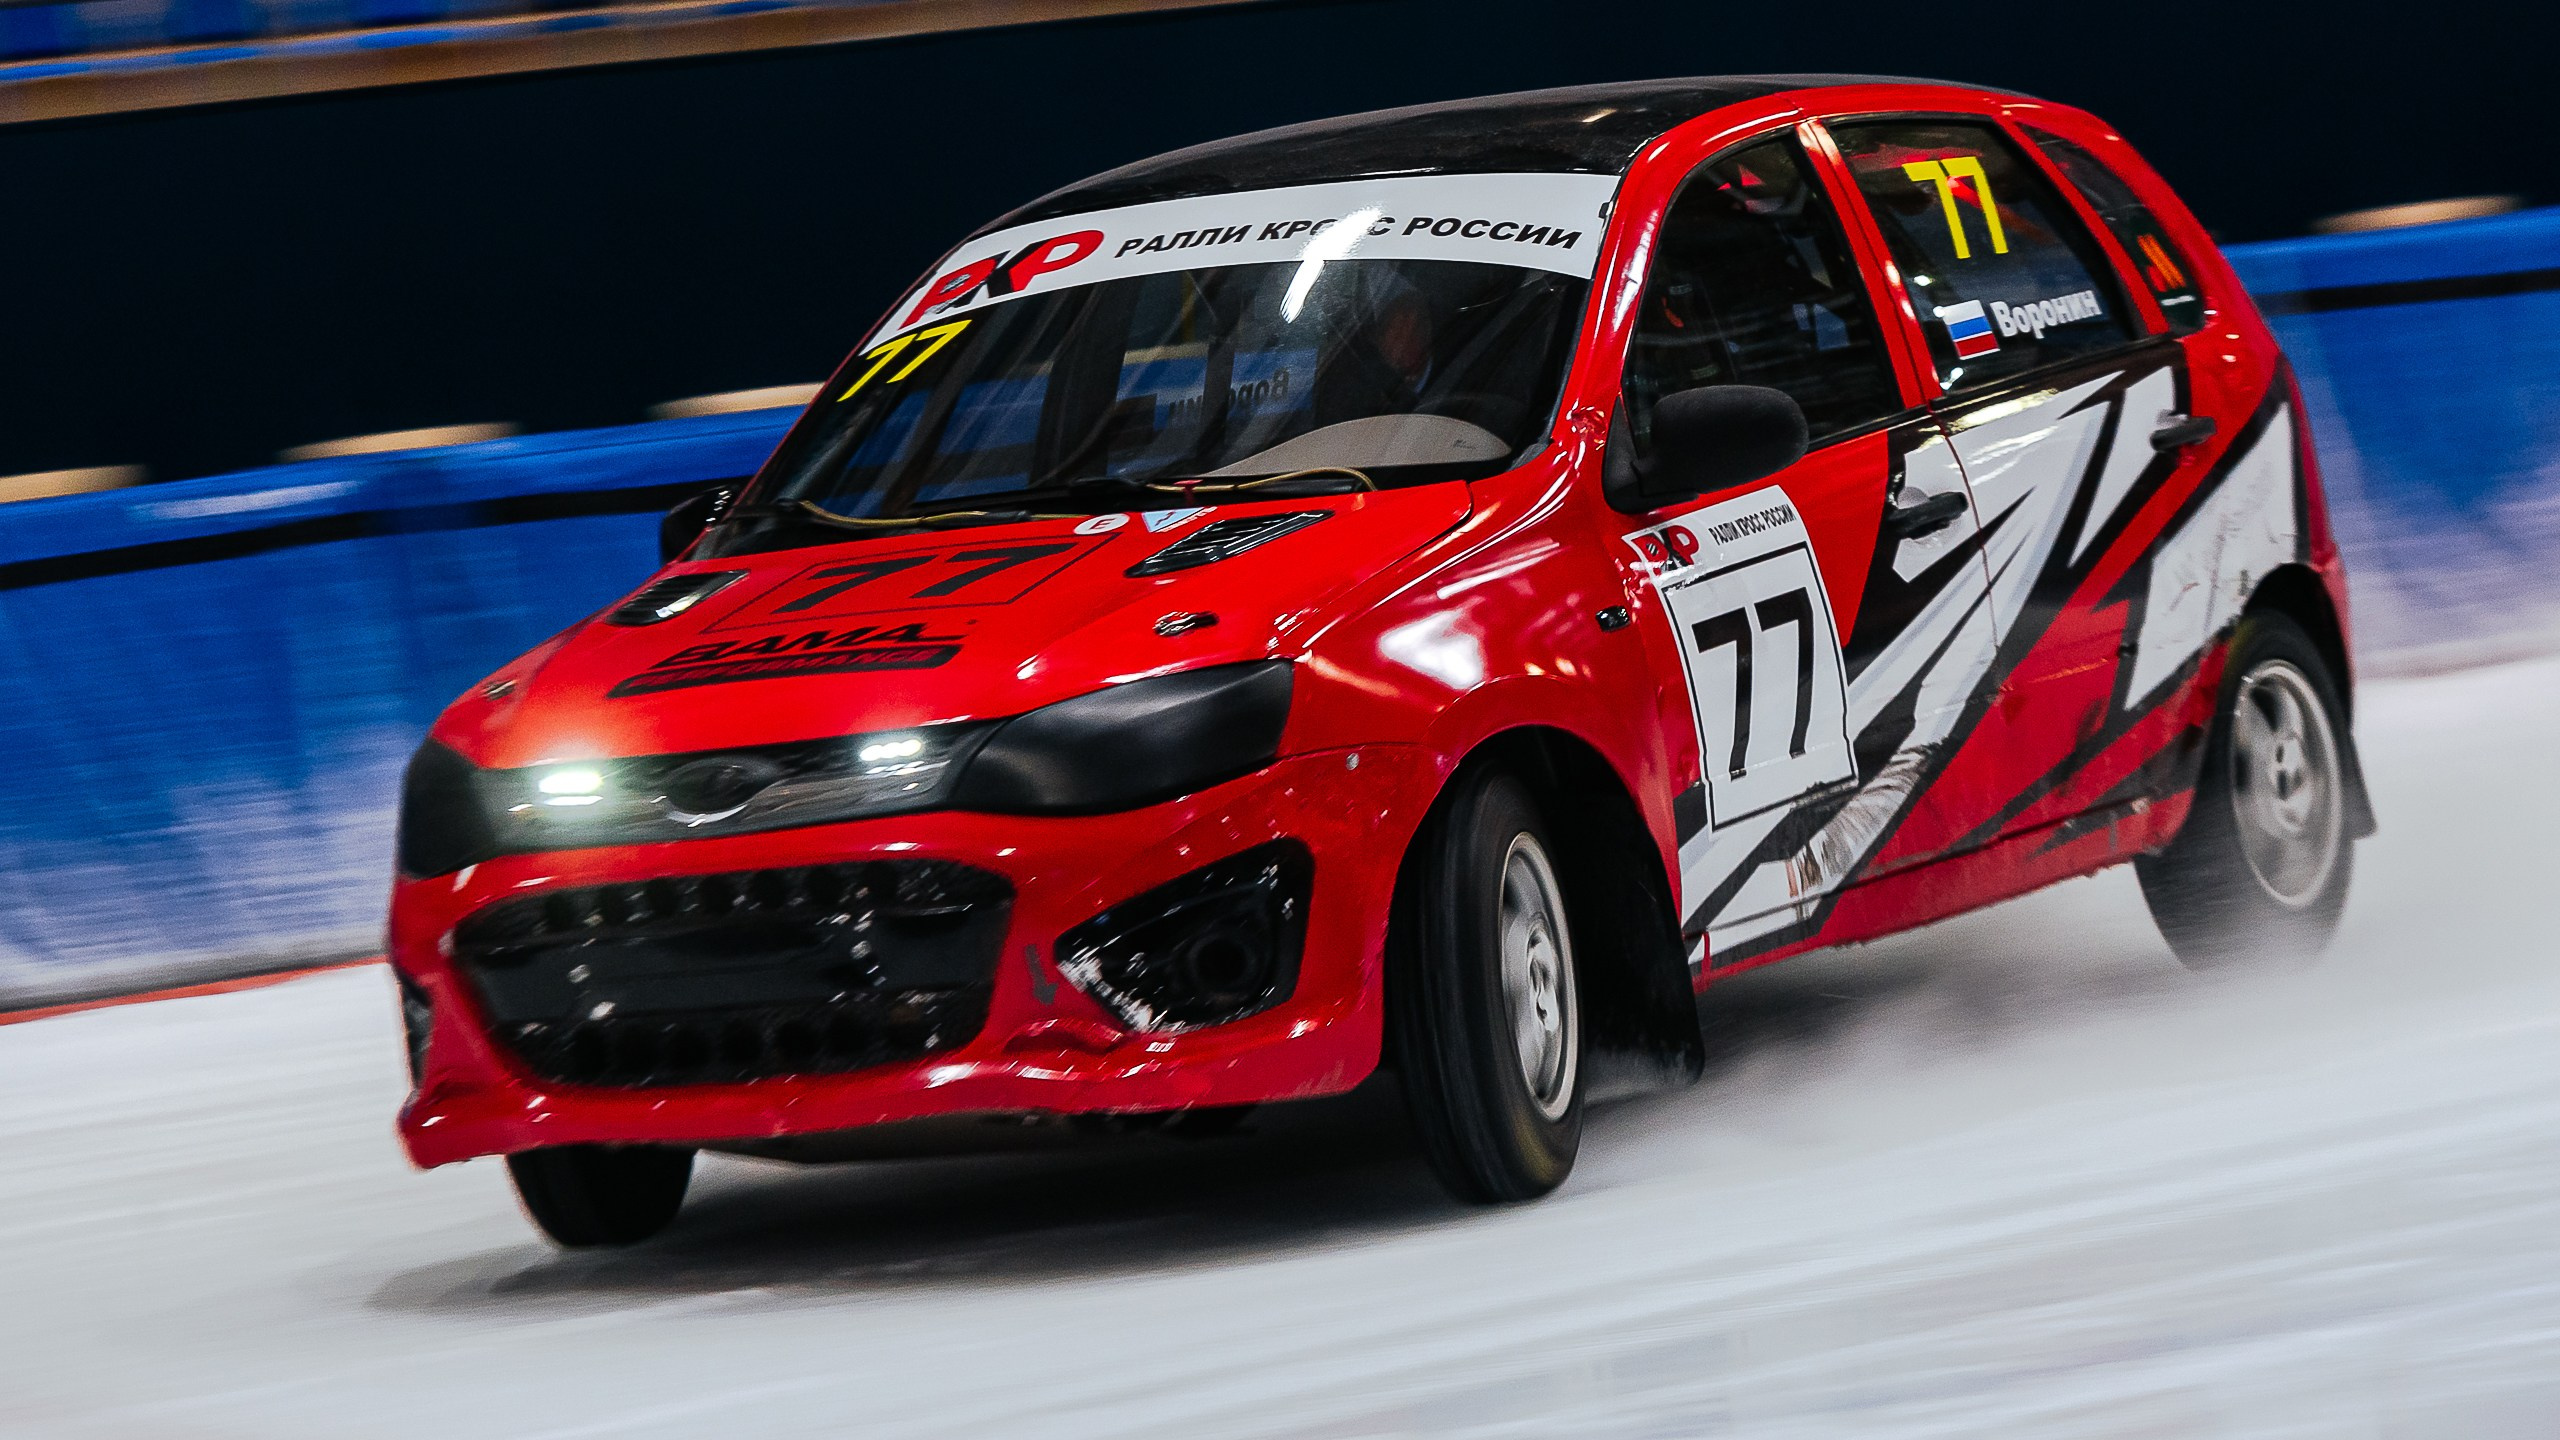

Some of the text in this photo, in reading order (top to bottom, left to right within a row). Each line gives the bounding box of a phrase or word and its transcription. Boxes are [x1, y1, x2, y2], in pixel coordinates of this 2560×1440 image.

[1114, 224, 1253, 259] РАЛЛИ
[1257, 216, 1396, 242] КРС
[1402, 217, 1583, 250] РОССИИ
[1901, 156, 2008, 259] 77
[1990, 290, 2103, 339] Воронин
[836, 319, 973, 403] 77
[769, 542, 1080, 615] 77
[1691, 586, 1815, 782] 77
